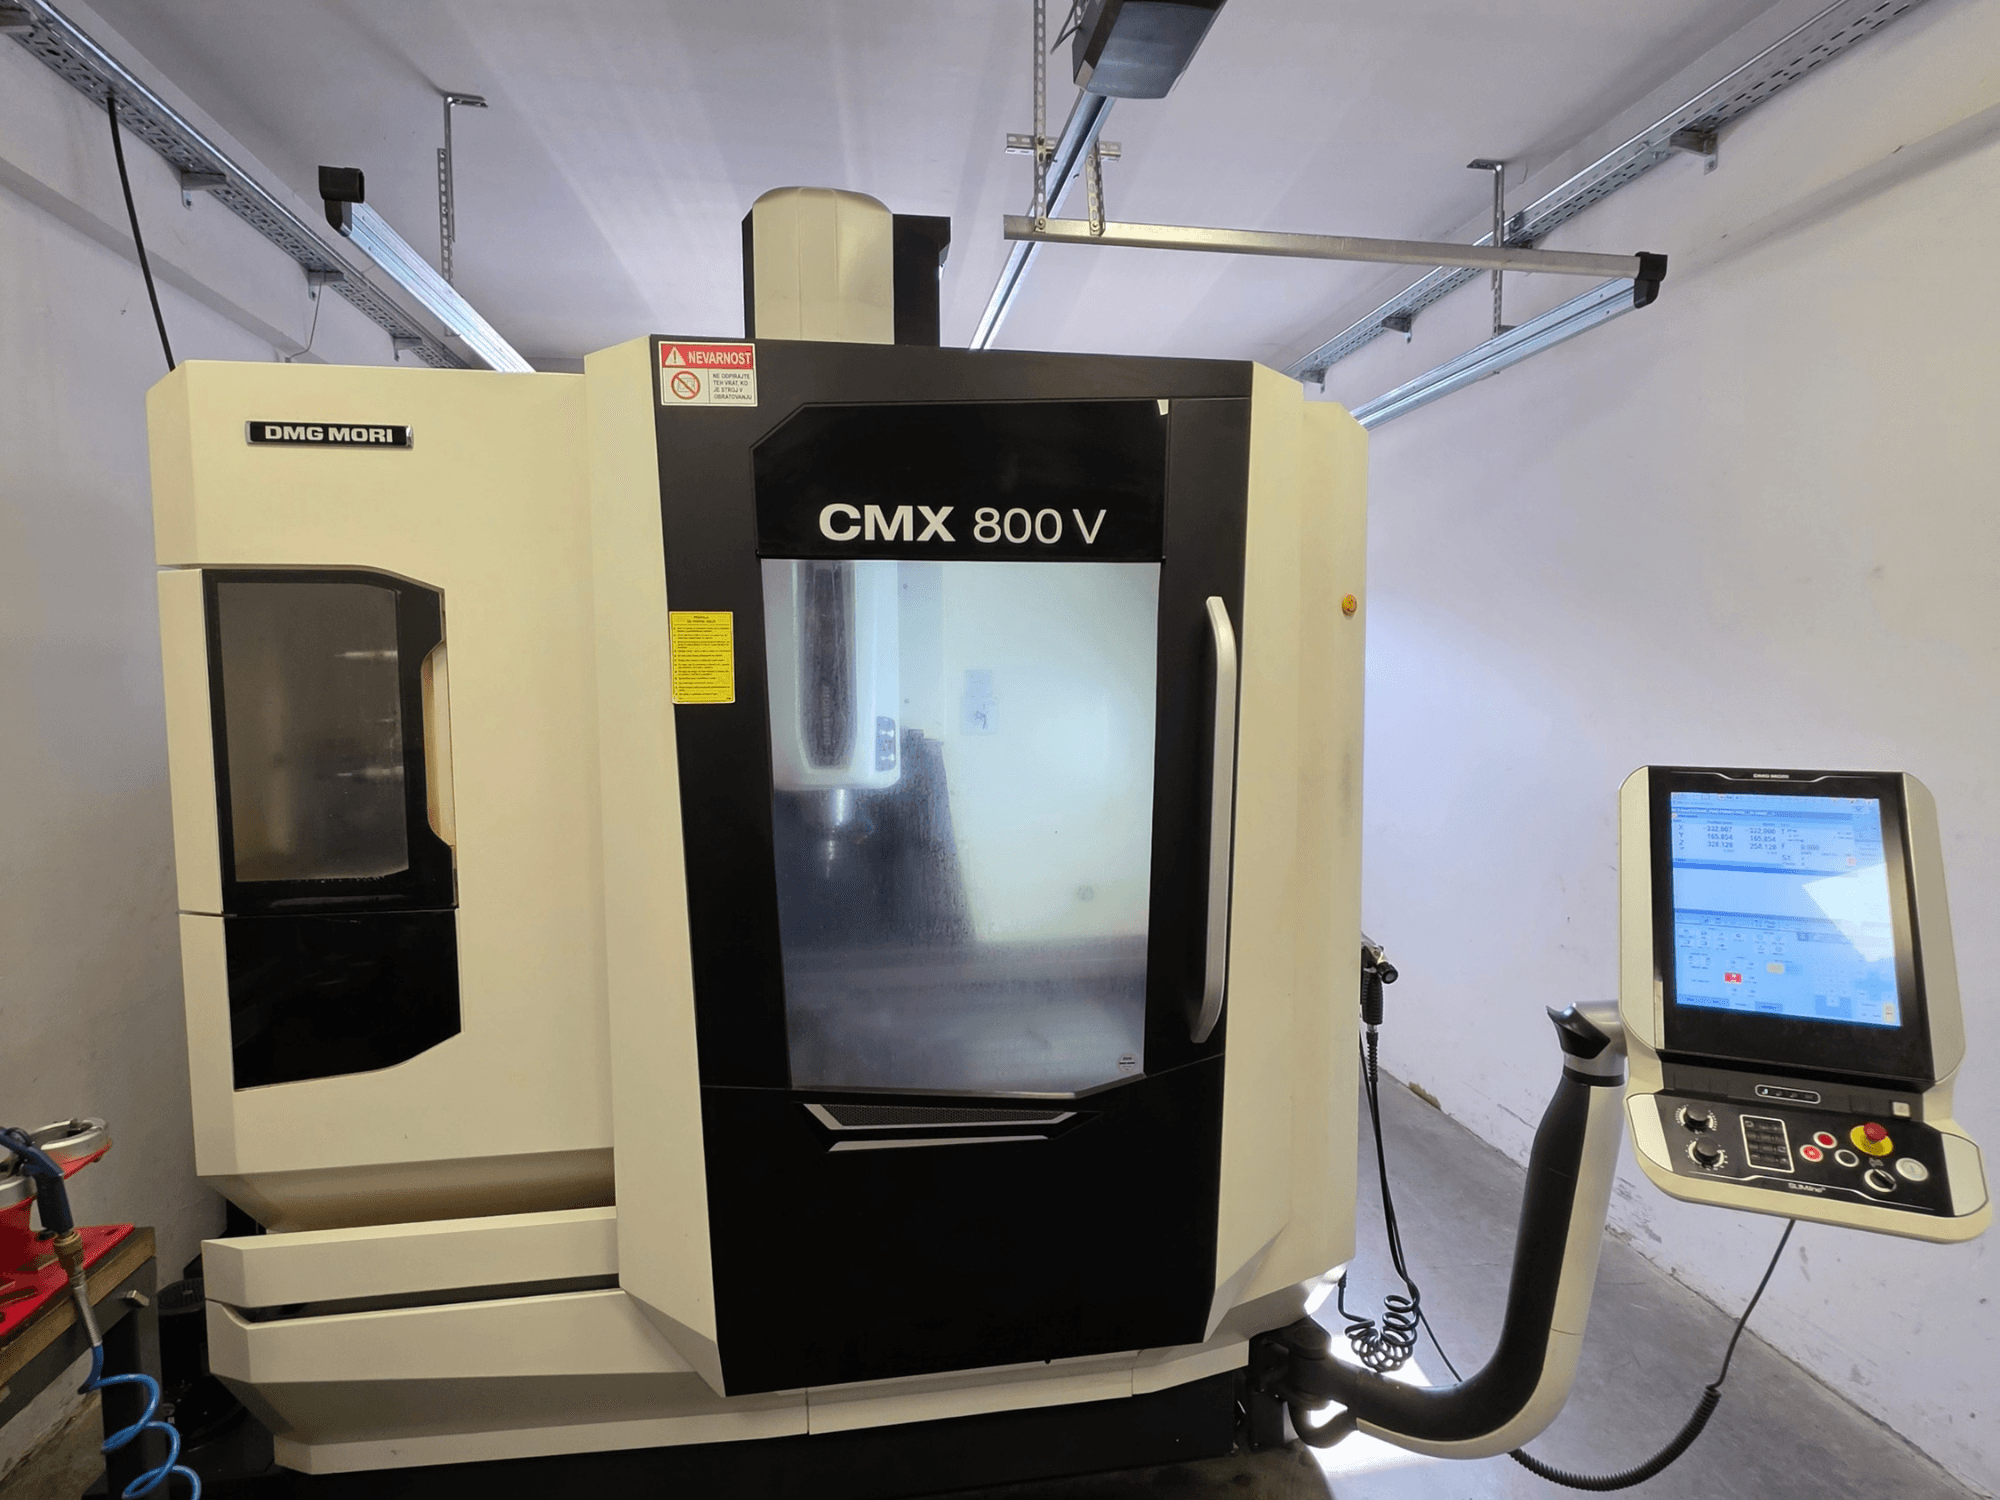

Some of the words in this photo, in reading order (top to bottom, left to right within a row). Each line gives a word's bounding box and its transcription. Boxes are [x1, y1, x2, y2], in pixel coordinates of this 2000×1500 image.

[688, 351, 752, 365] NEVARNOST
[264, 425, 324, 441] DMG
[328, 426, 394, 443] MORI
[818, 503, 956, 542] CMX
[973, 506, 1063, 544] 800
[1072, 508, 1107, 544] V
